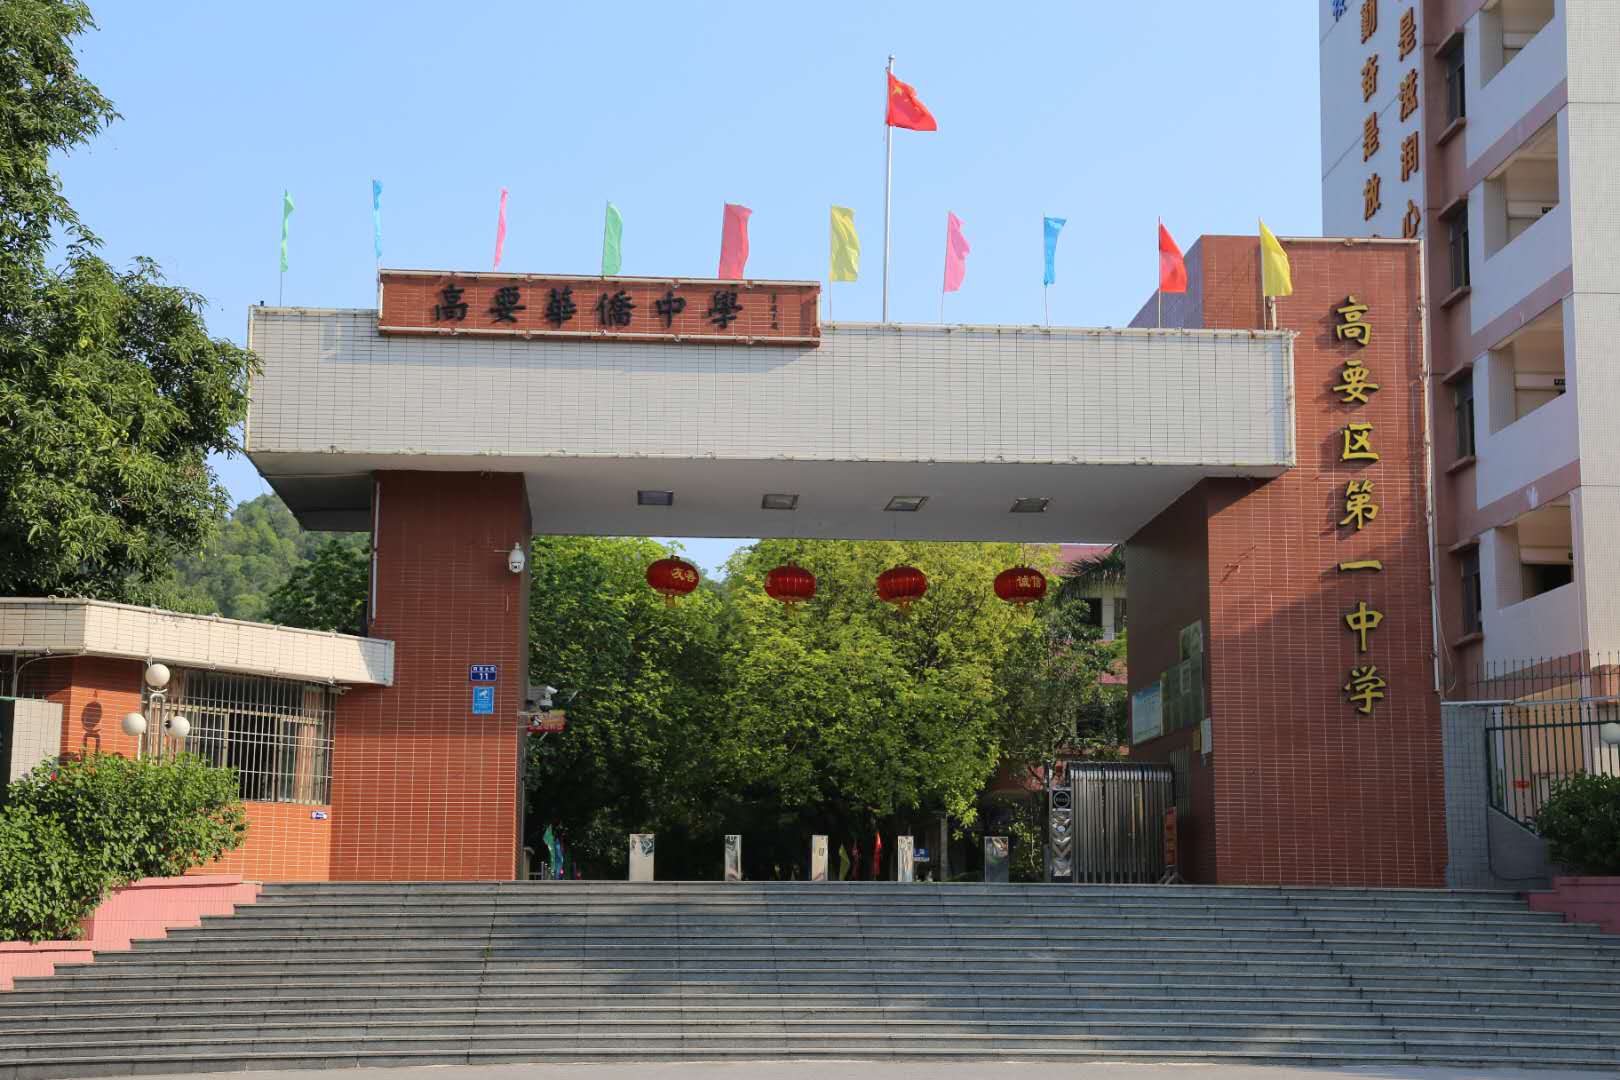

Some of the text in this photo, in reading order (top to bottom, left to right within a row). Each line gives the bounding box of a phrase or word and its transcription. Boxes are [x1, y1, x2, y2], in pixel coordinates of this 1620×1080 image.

[1333, 296, 1386, 713] 高要区第一中学
